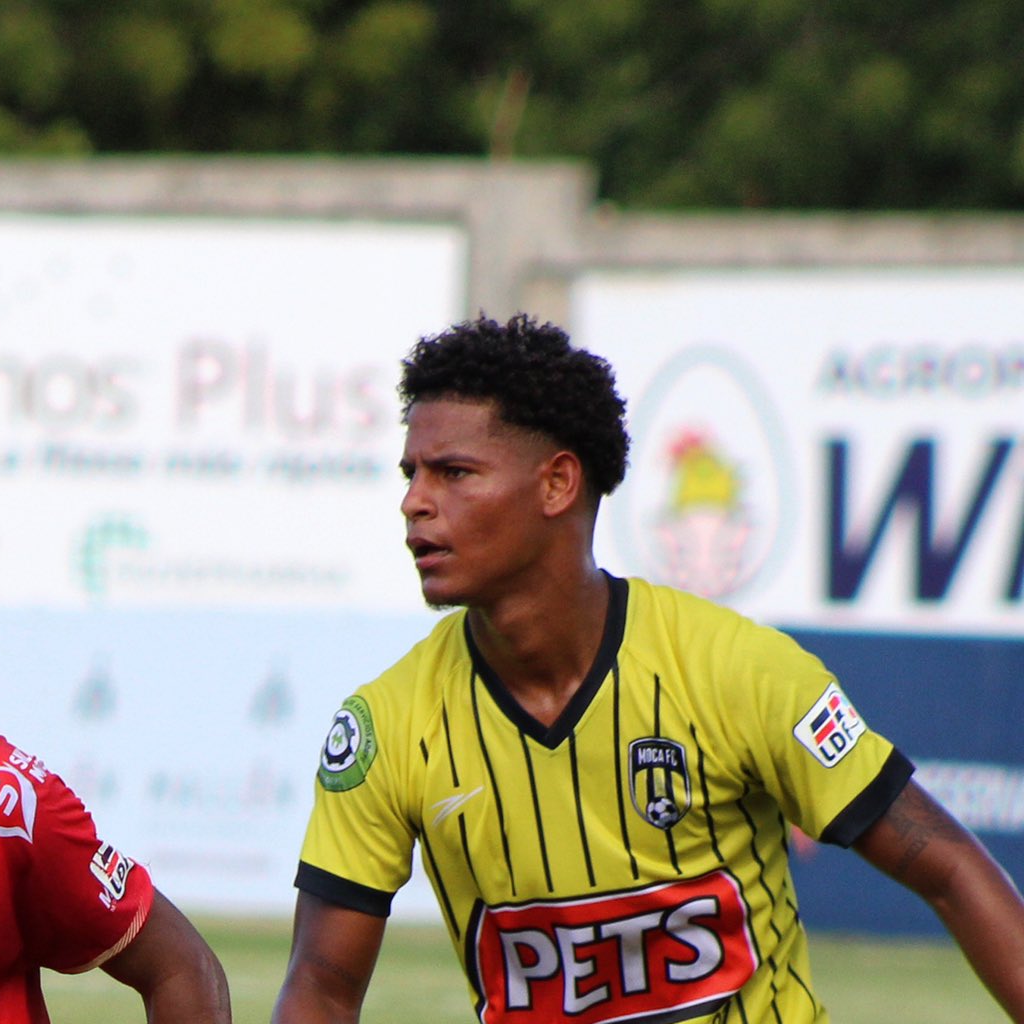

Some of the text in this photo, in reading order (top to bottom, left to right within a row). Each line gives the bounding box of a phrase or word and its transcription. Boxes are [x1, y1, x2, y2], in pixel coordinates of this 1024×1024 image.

[176, 338, 388, 435] Plus
[637, 747, 678, 767] MOCA FC
[499, 896, 723, 1015] PETS
